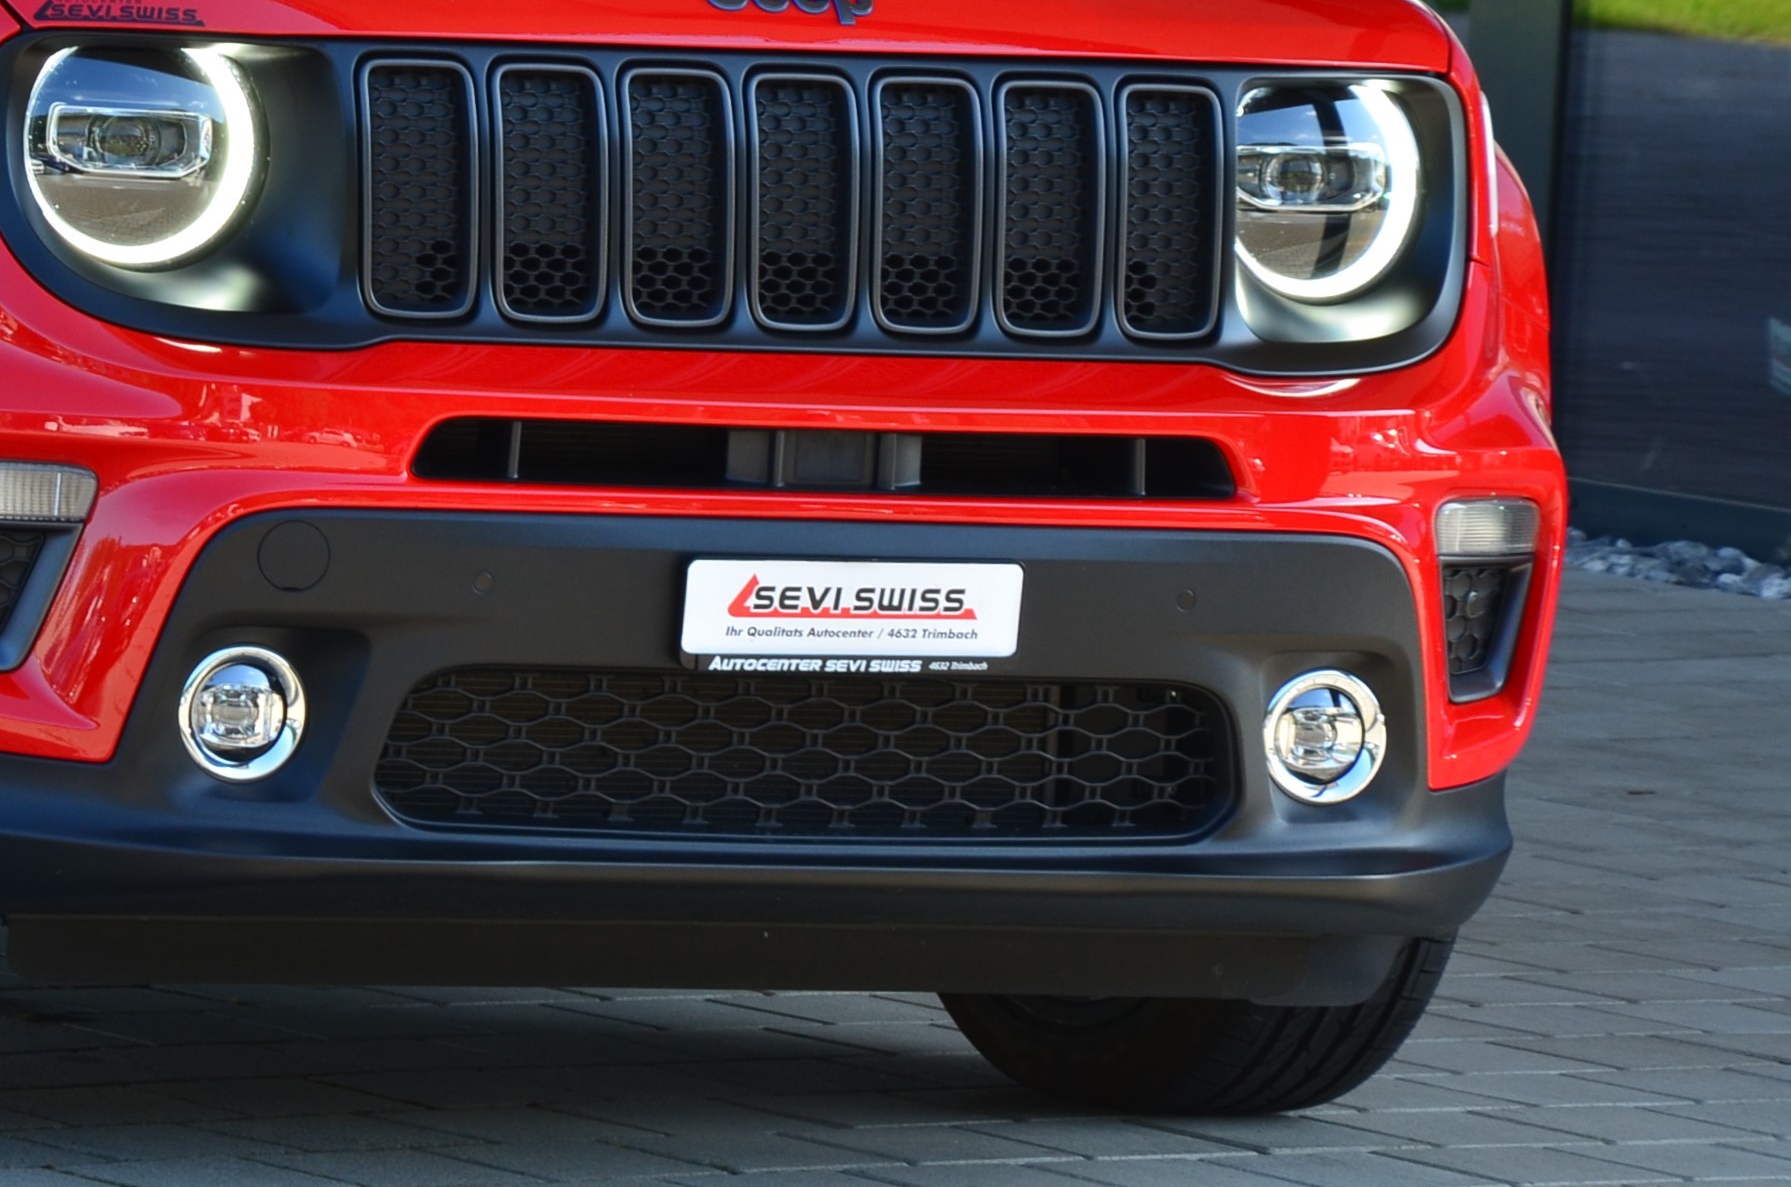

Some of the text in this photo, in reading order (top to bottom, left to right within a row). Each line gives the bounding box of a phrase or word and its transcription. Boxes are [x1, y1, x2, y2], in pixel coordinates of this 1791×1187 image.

[51, 3, 198, 22] SEVI SWISS
[753, 586, 966, 613] SEVI SWISS
[726, 626, 743, 637] Ihr
[747, 626, 803, 638] Qualitats
[807, 627, 874, 639] Autocenter
[888, 628, 917, 639] 4632
[922, 628, 978, 640] Trimbach
[825, 659, 868, 672] SEVI
[869, 660, 922, 673] SWISS
